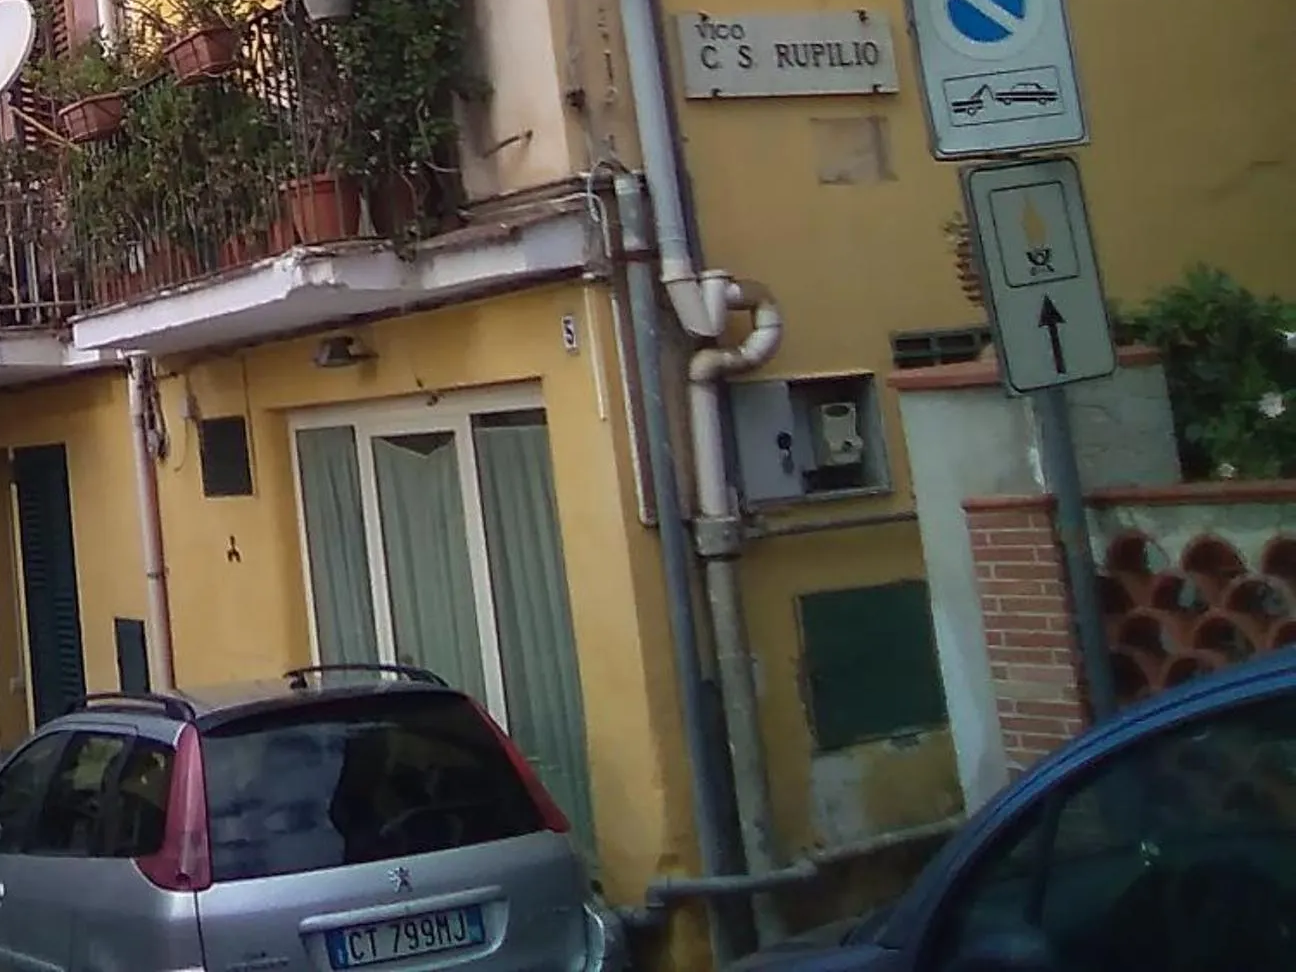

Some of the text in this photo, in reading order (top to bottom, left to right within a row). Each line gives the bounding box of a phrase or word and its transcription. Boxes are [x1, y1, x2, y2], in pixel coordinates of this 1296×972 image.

[694, 22, 745, 40] VICO
[774, 41, 880, 69] RUPILIO
[348, 928, 378, 961] CT
[390, 910, 467, 954] 799MJ
